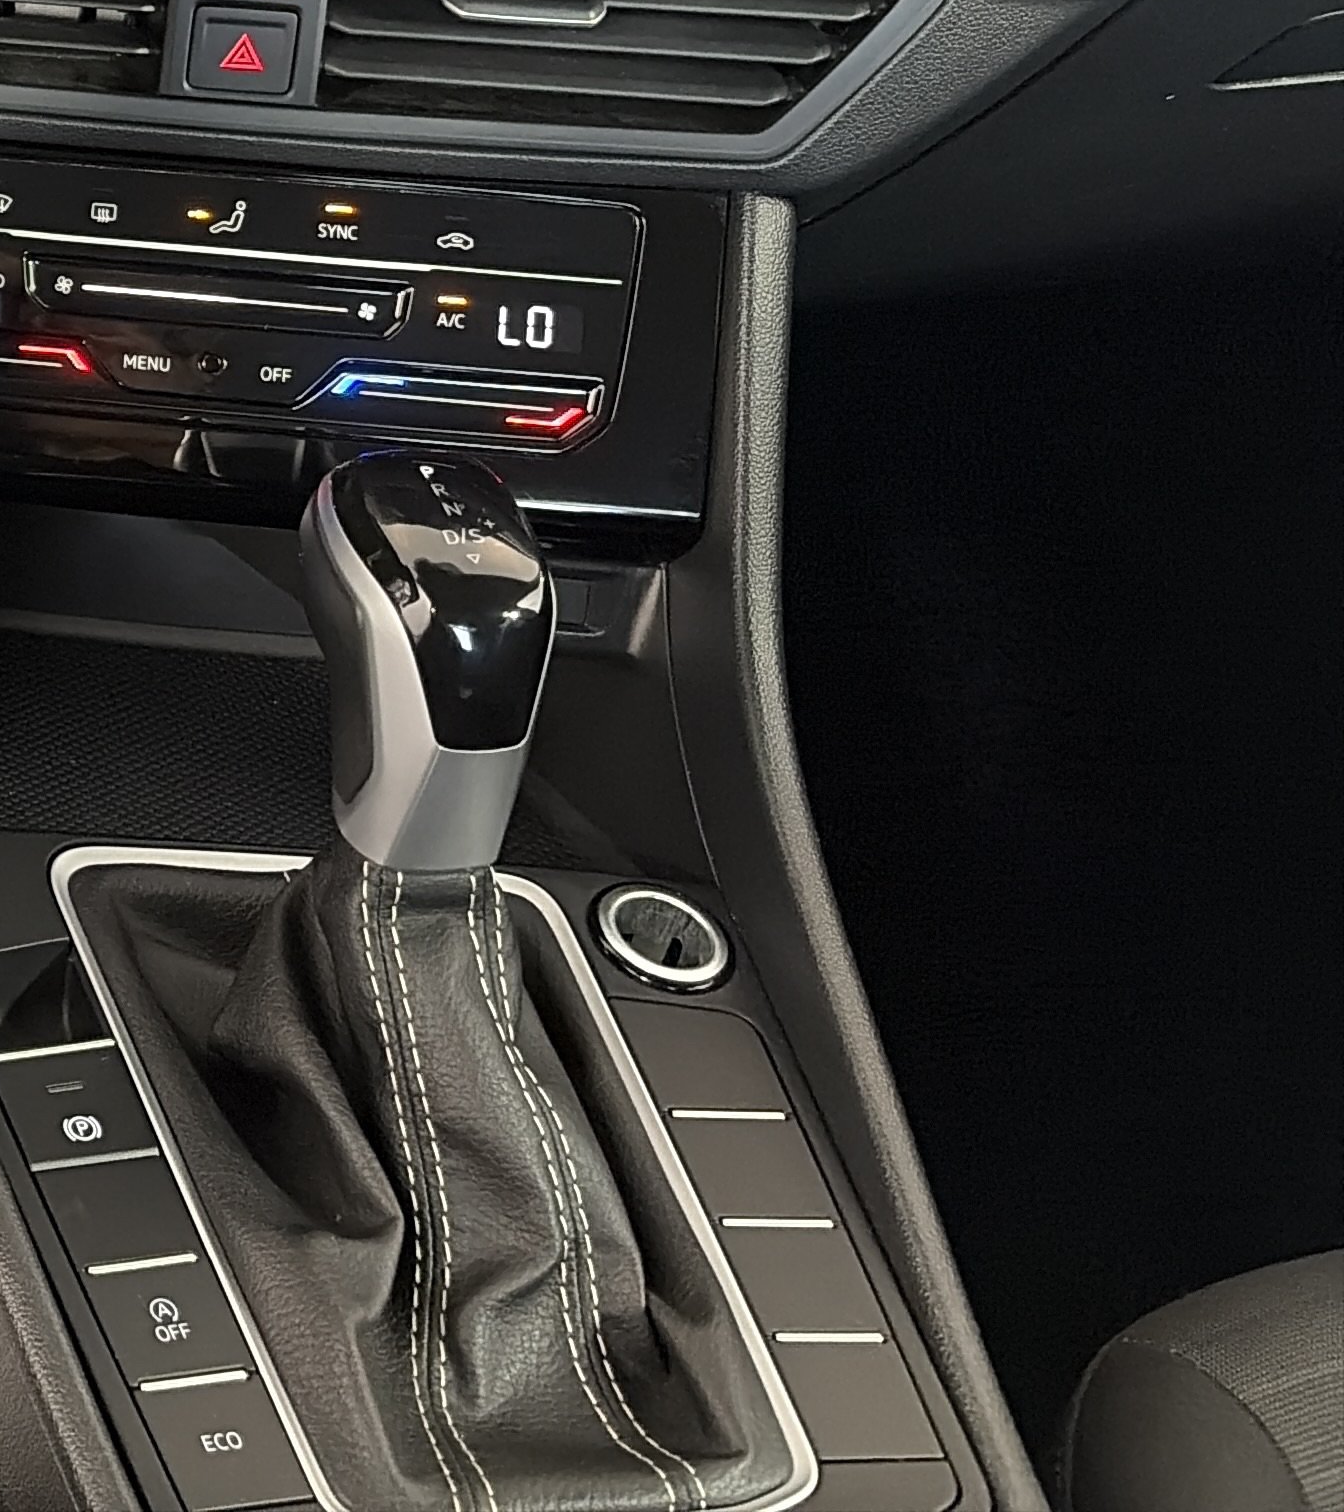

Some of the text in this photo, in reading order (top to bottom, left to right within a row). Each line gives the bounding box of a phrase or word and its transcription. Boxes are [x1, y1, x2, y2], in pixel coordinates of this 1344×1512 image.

[317, 223, 358, 242] SYNC
[436, 311, 466, 330] A/C
[497, 304, 554, 350] LO
[123, 353, 172, 374] MENU
[260, 365, 292, 385] OFF
[419, 465, 434, 479] P
[430, 483, 450, 497] R
[441, 502, 462, 516] N
[442, 528, 486, 545] D/S
[154, 1323, 191, 1342] OFF
[200, 1431, 243, 1452] ECO
